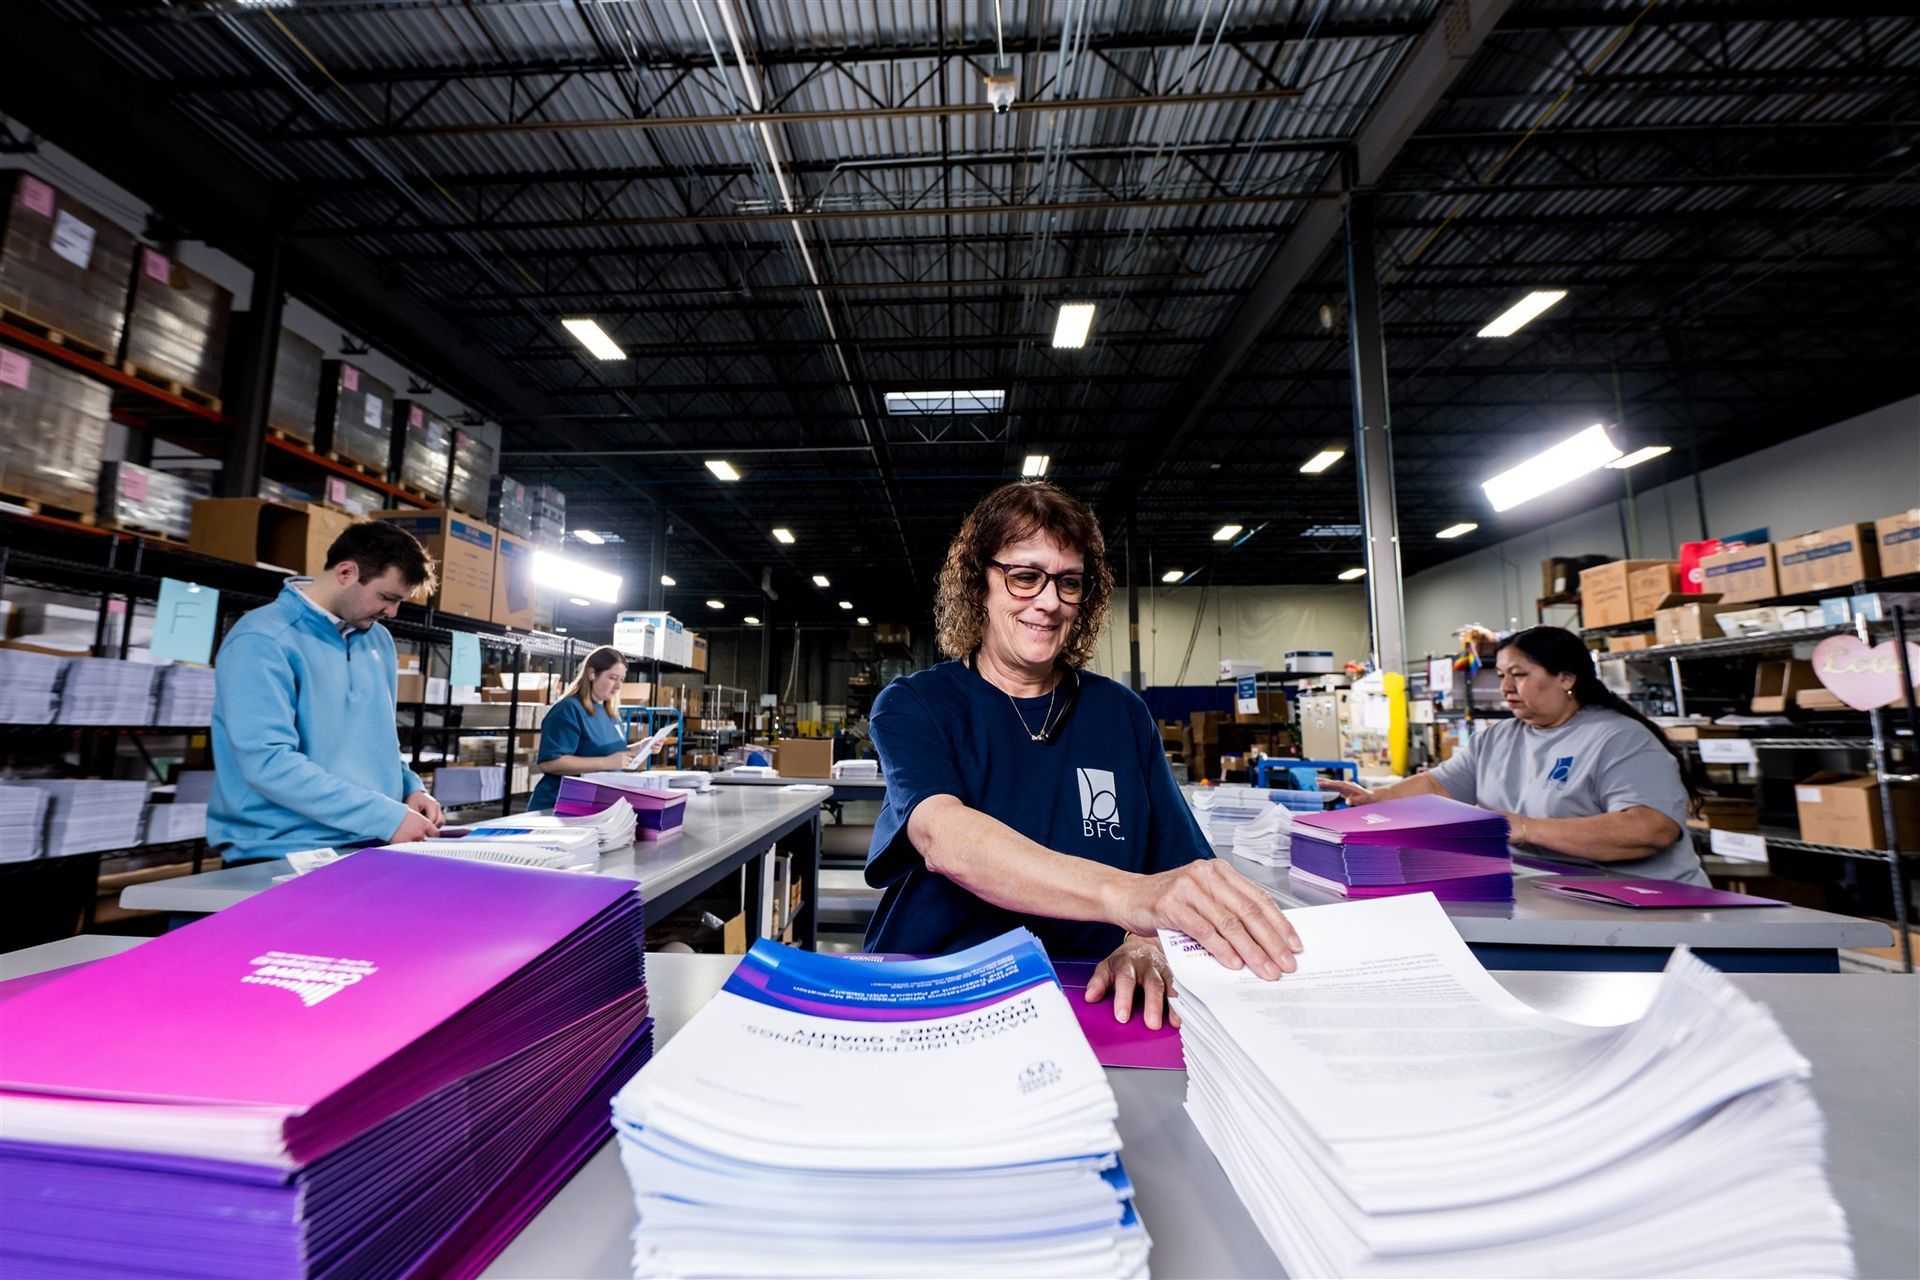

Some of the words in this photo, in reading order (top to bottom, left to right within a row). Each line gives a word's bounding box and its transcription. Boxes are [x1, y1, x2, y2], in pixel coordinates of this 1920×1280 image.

[169, 601, 201, 634] F
[456, 646, 469, 667] F
[987, 968, 1019, 984] Setting
[793, 986, 844, 999] Medication
[927, 982, 986, 999] Expectations
[942, 977, 987, 993] Treatment
[845, 994, 897, 1002] Prescribing
[900, 1005, 1016, 1035] OUTCOMES
[981, 1012, 1038, 1039] MAYO
[794, 1029, 885, 1043] QUALITY
[904, 1034, 976, 1052] CLINIC
